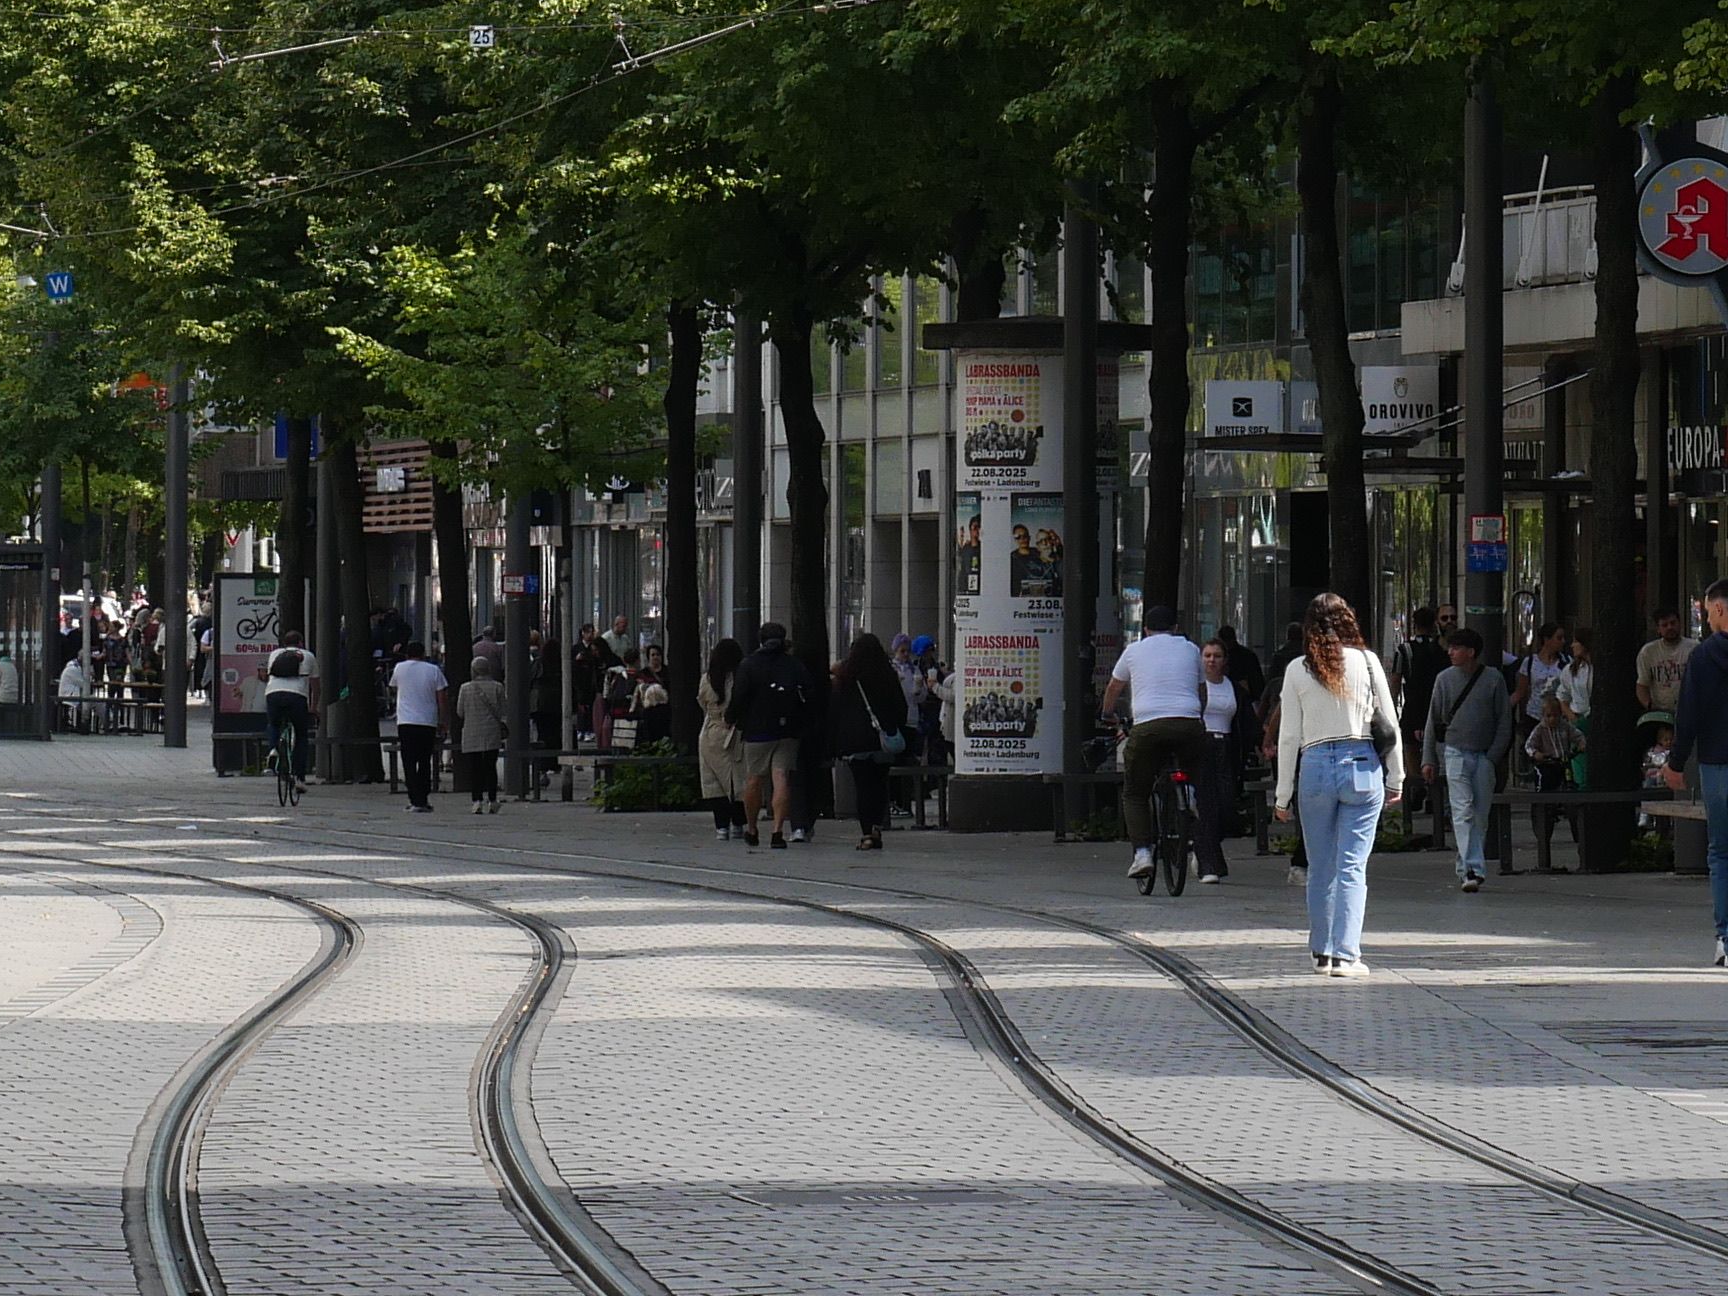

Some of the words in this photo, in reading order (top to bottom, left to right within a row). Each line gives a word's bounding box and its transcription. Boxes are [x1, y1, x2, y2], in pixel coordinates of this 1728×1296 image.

[473, 29, 490, 44] 25
[49, 275, 68, 294] W
[965, 364, 1041, 378] LABRASSBANDA
[1369, 404, 1434, 420] OROVIVO
[1215, 425, 1246, 436] MISTER
[996, 447, 1027, 460] party
[971, 468, 1027, 478] 22.08.2025
[996, 478, 1041, 488] Ladenburg
[1013, 610, 1054, 620] Festwiese
[964, 635, 1040, 649] LABRASSBANDA
[995, 720, 1026, 732] party
[970, 739, 1027, 749] 22.08.2025
[996, 749, 1040, 759] Ladenburg
